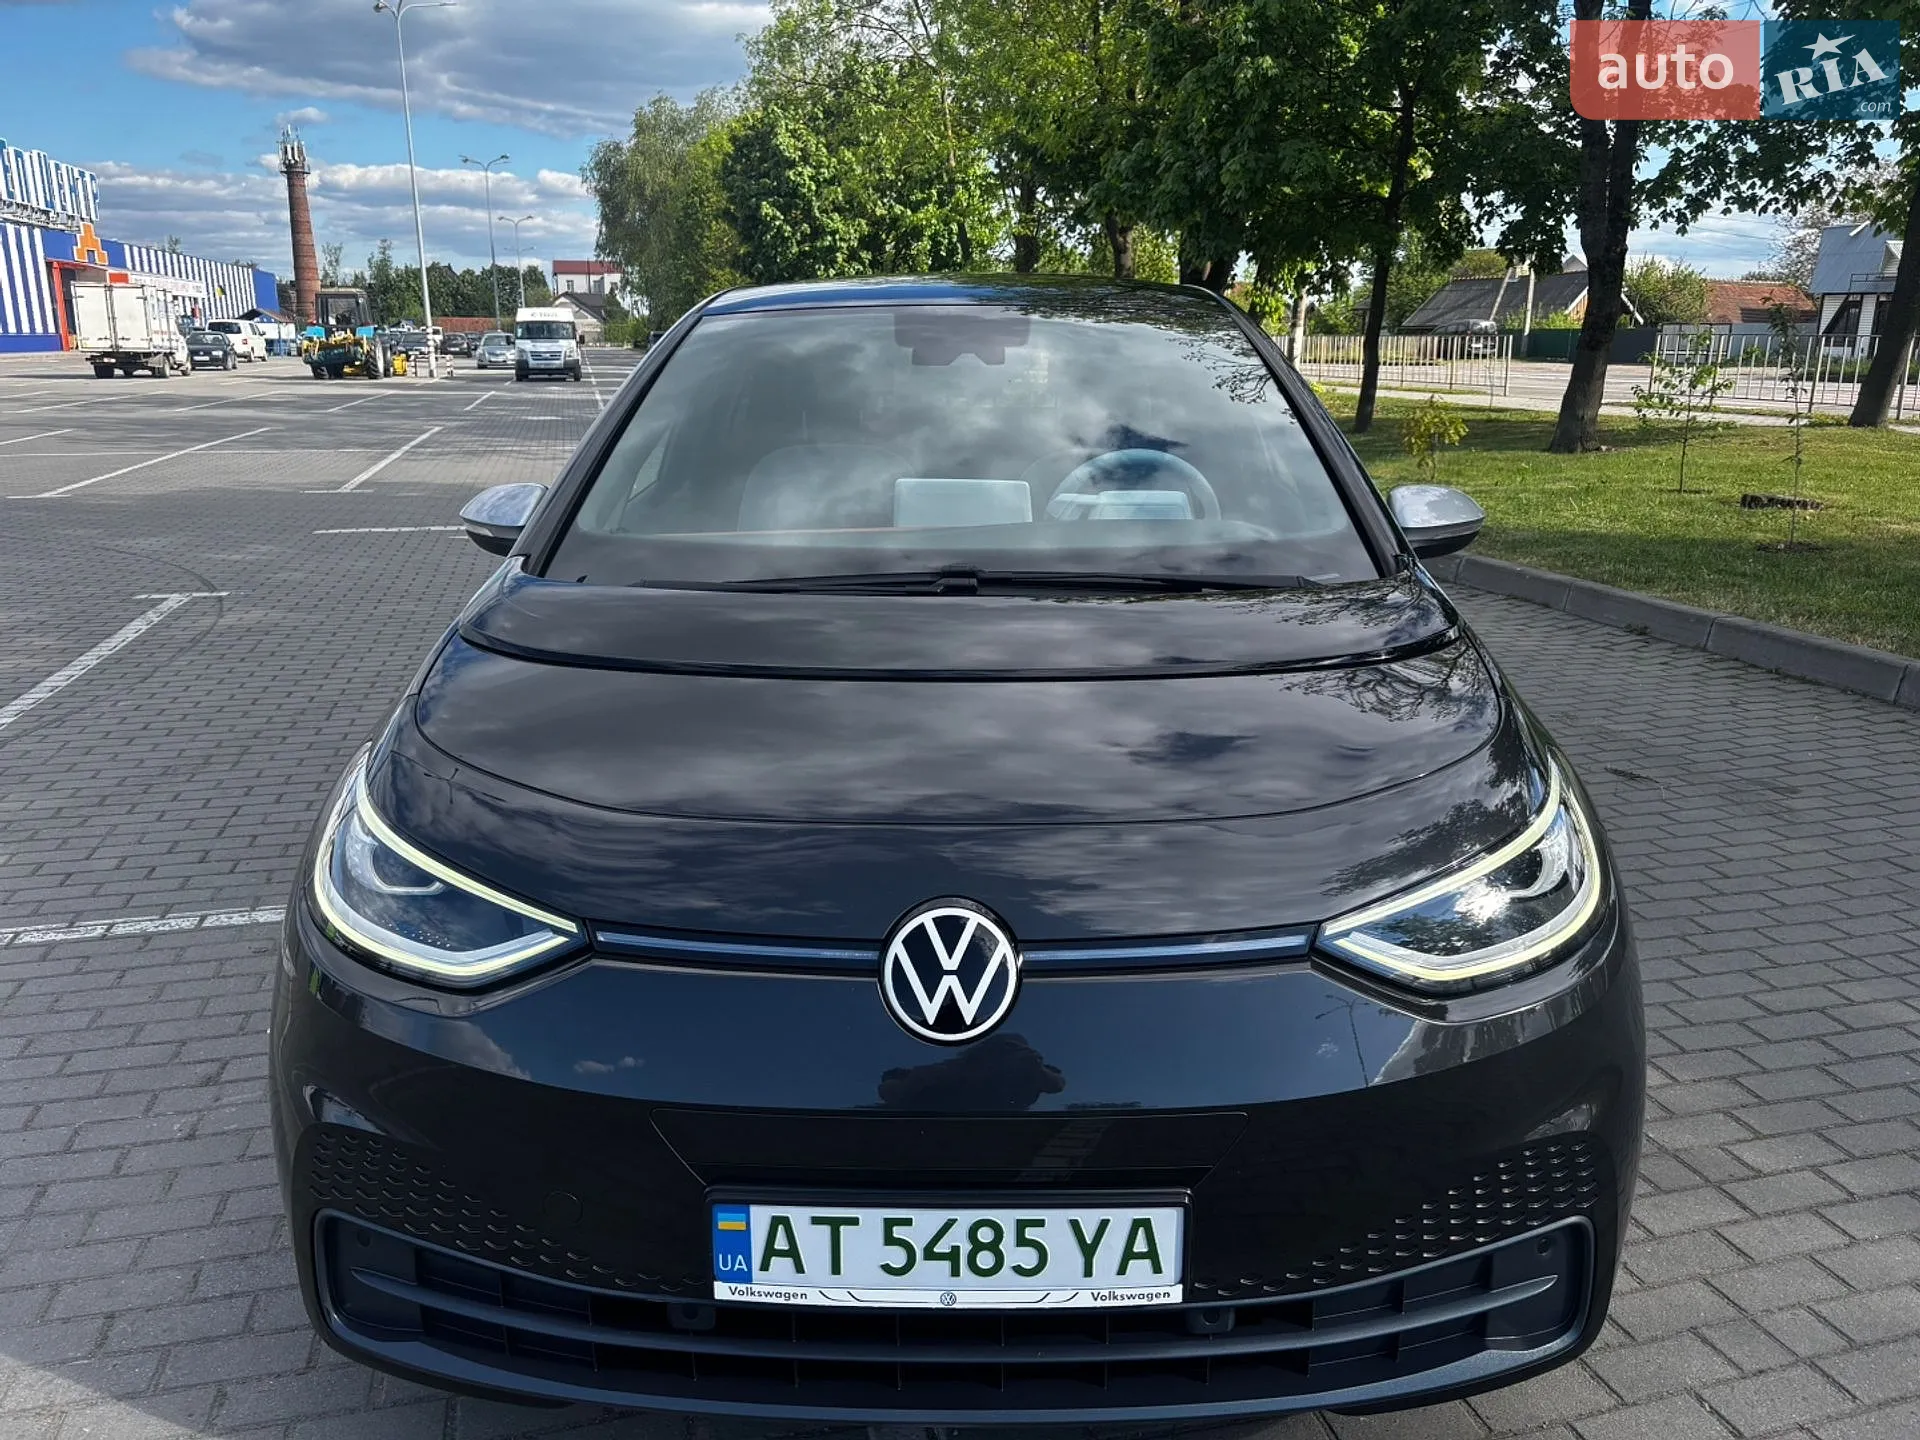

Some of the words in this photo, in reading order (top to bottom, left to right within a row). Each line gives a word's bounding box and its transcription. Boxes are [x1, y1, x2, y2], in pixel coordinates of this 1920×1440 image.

[758, 1215, 860, 1275] AT
[879, 1217, 1050, 1278] 5485
[1069, 1218, 1164, 1278] YA
[718, 1254, 748, 1273] UA
[728, 1285, 808, 1301] Volkswagen
[1091, 1290, 1171, 1303] Volkswagen
